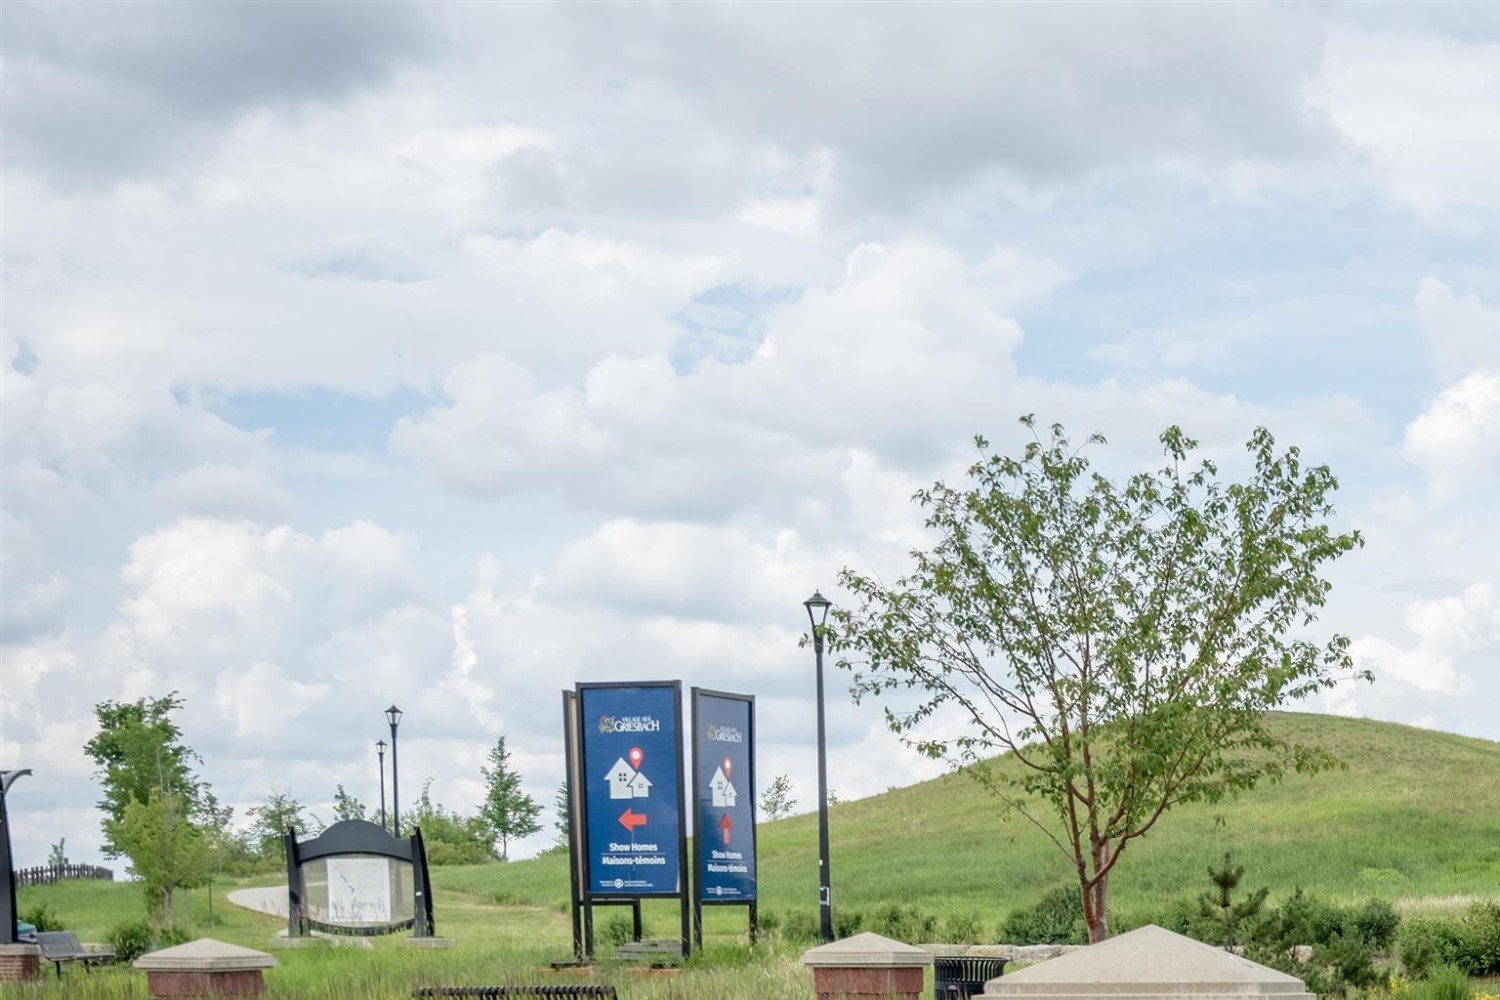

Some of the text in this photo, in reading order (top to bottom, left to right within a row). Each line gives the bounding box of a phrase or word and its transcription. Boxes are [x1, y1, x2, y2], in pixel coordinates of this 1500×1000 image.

[614, 720, 660, 732] GRIESBACH
[609, 842, 658, 852] Show Homes
[712, 850, 726, 859] Show
[602, 855, 666, 865] Maisons-témoins
